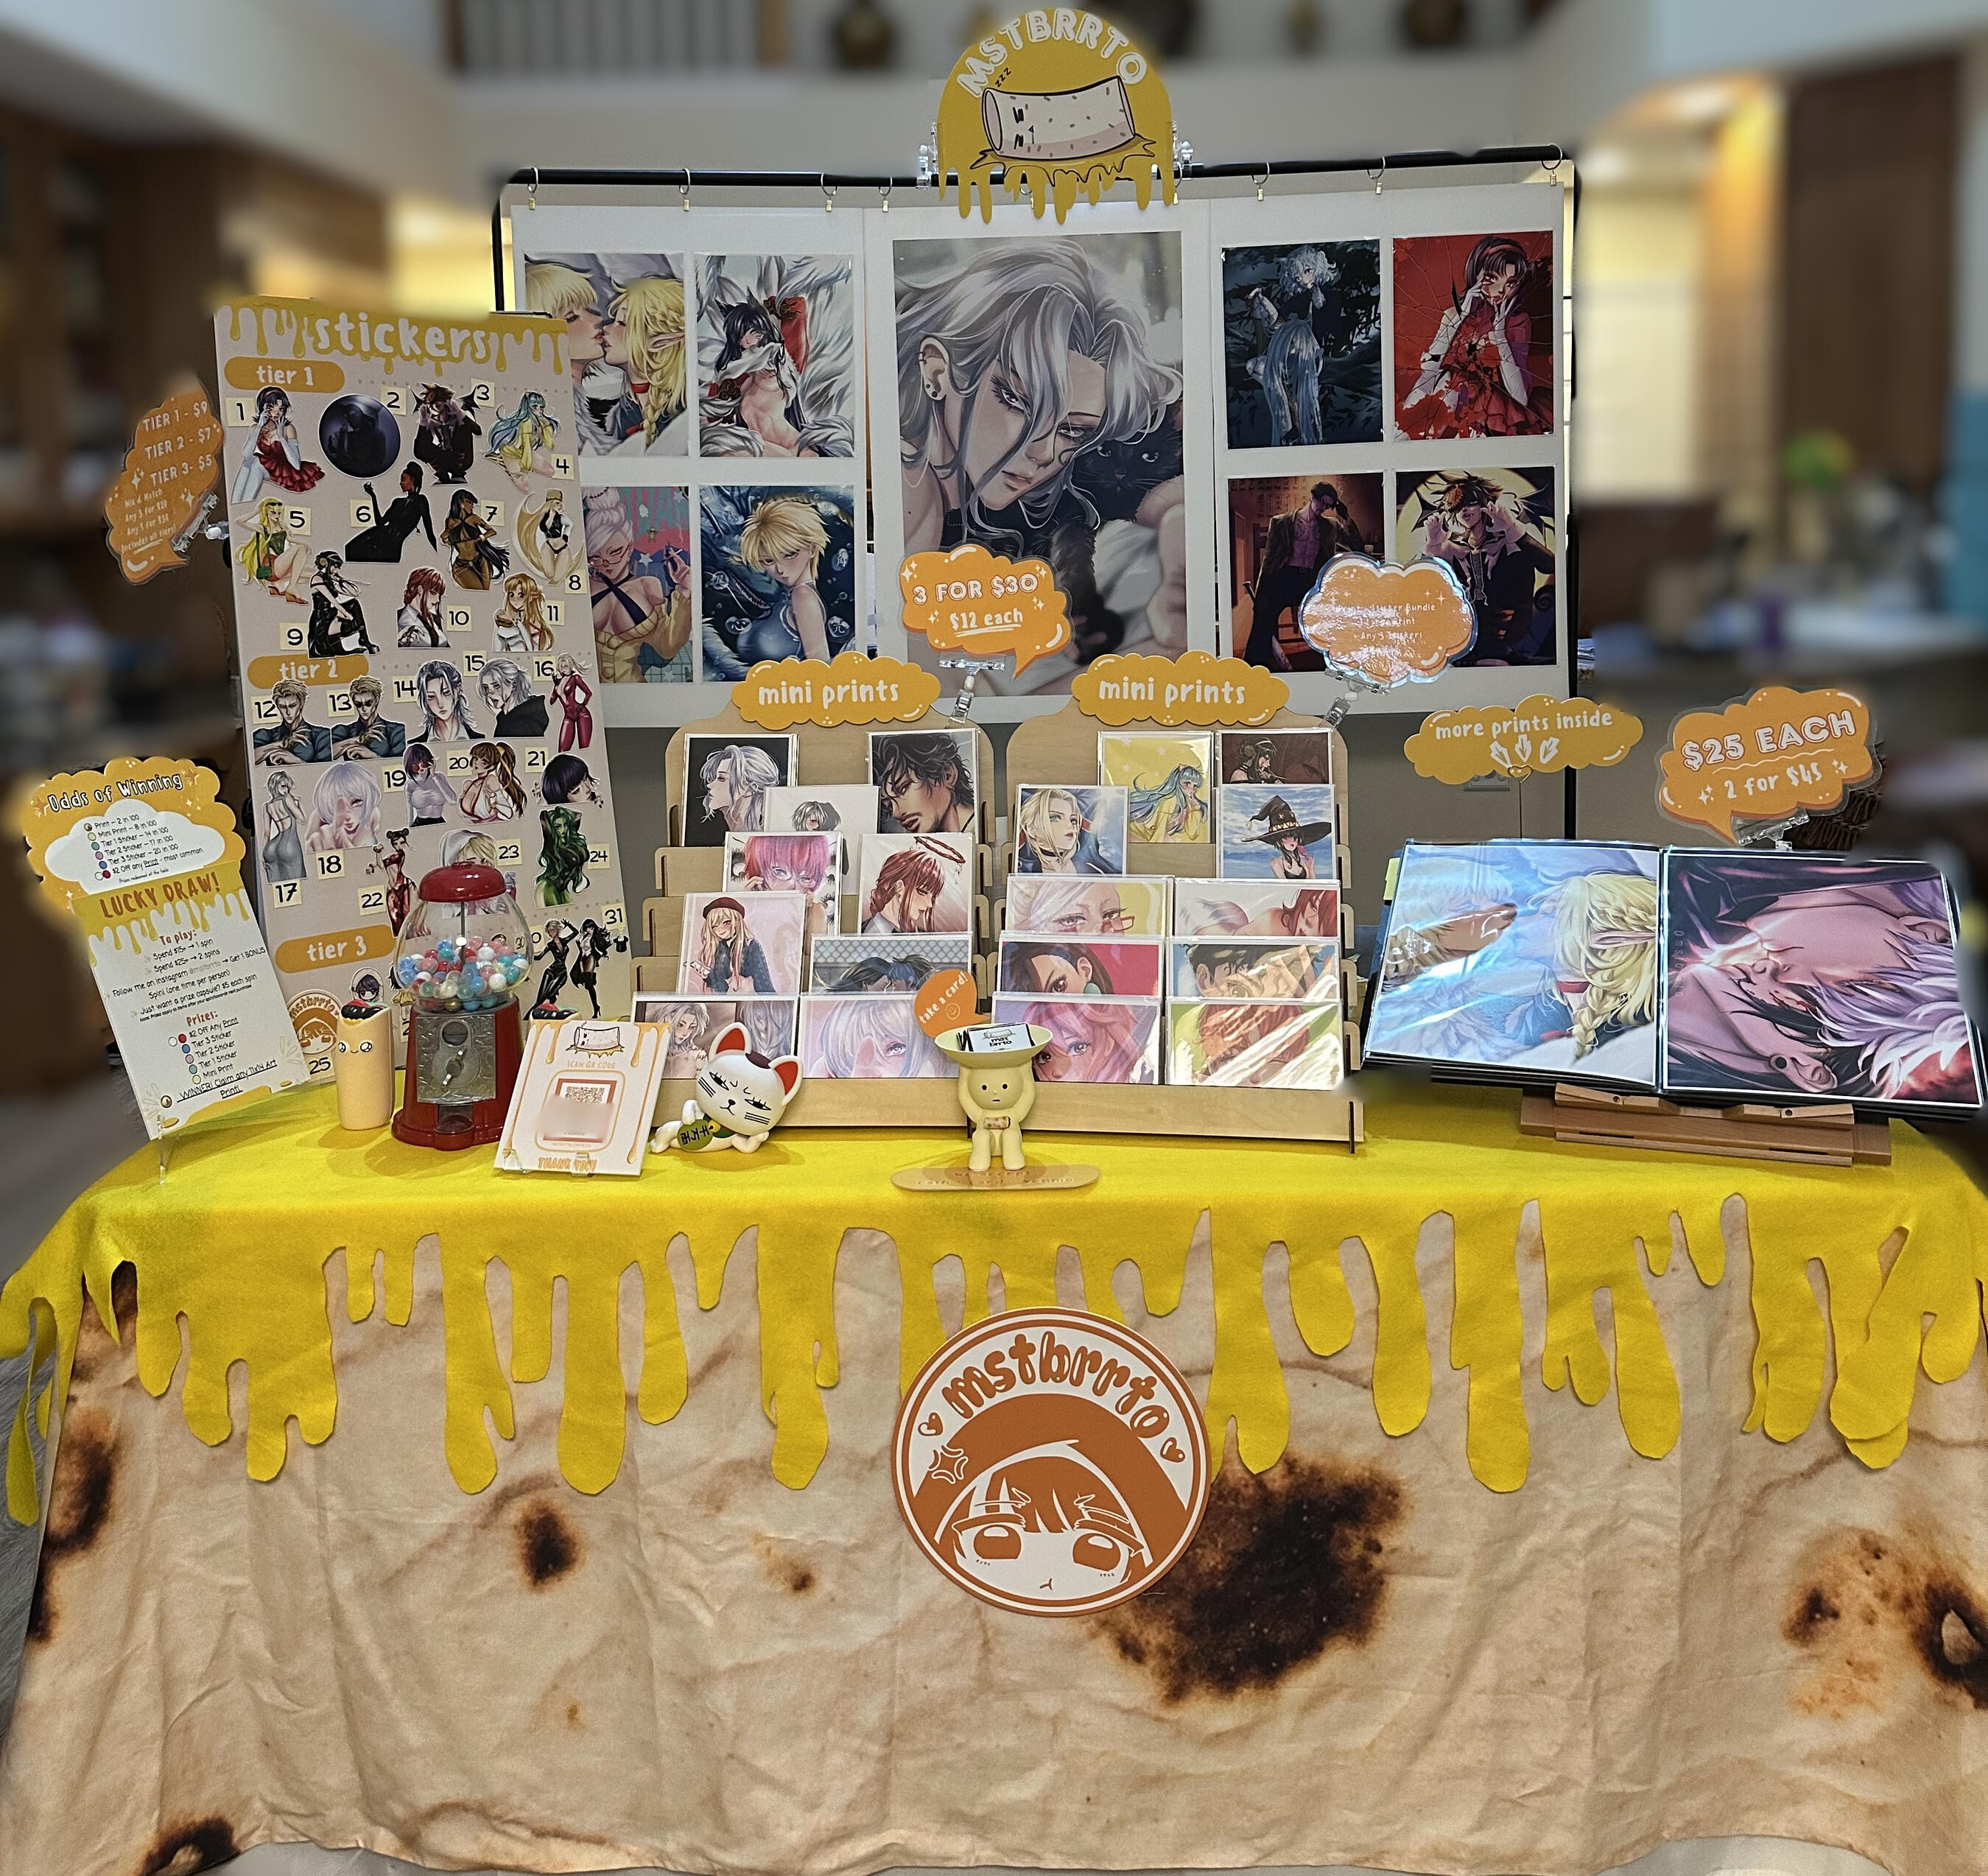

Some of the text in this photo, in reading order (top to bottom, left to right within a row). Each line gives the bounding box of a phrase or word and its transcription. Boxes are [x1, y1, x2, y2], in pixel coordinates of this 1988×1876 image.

[958, 8, 1148, 98] MSTBRRTO
[315, 312, 490, 359] stickers
[256, 365, 314, 387] tier 1
[387, 392, 401, 408] 2
[477, 384, 491, 401] 3
[143, 401, 208, 432] TIER 1 $9
[236, 401, 246, 421] 1
[144, 427, 211, 460] TIER 2 $7
[150, 454, 213, 486] TIER $5
[555, 458, 570, 474] 4
[289, 512, 306, 529] 5
[356, 506, 370, 522] 6
[485, 505, 498, 522] 7
[569, 575, 582, 590] 8
[913, 573, 1039, 605] 3 FOR $30
[448, 610, 470, 626] 10
[547, 605, 558, 622] 11
[949, 608, 1023, 631] $12 each
[287, 628, 304, 647] 9
[279, 659, 338, 683] tier 2
[465, 654, 484, 672] 15
[535, 660, 555, 677] 16
[394, 681, 417, 698] 14
[759, 679, 899, 709] mini prints
[1099, 675, 1245, 708] mini prints
[255, 700, 277, 719] 12
[329, 693, 351, 712] 13
[1436, 710, 1612, 739] more prints inside
[1682, 709, 1856, 771] $25 EACH
[449, 756, 469, 770] 20
[527, 751, 546, 767] 21
[384, 770, 407, 788] 19
[1724, 762, 1822, 798] 2 for $45
[47, 773, 184, 813] Odds of Winning
[498, 845, 520, 860] 23
[589, 850, 608, 863] 24
[320, 856, 342, 875] 18
[99, 890, 156, 918] LUCKY
[163, 871, 220, 903] DRAW!
[275, 882, 298, 904] 17
[362, 892, 383, 907] 22
[604, 907, 623, 925] 31
[159, 930, 197, 946] To play:
[152, 949, 173, 961] Spend
[306, 937, 367, 963] tier 3
[153, 961, 174, 973] Spend
[919, 972, 969, 1024] take a card!
[309, 1056, 331, 1075] 25
[941, 1329, 1170, 1438] mstbrrto
